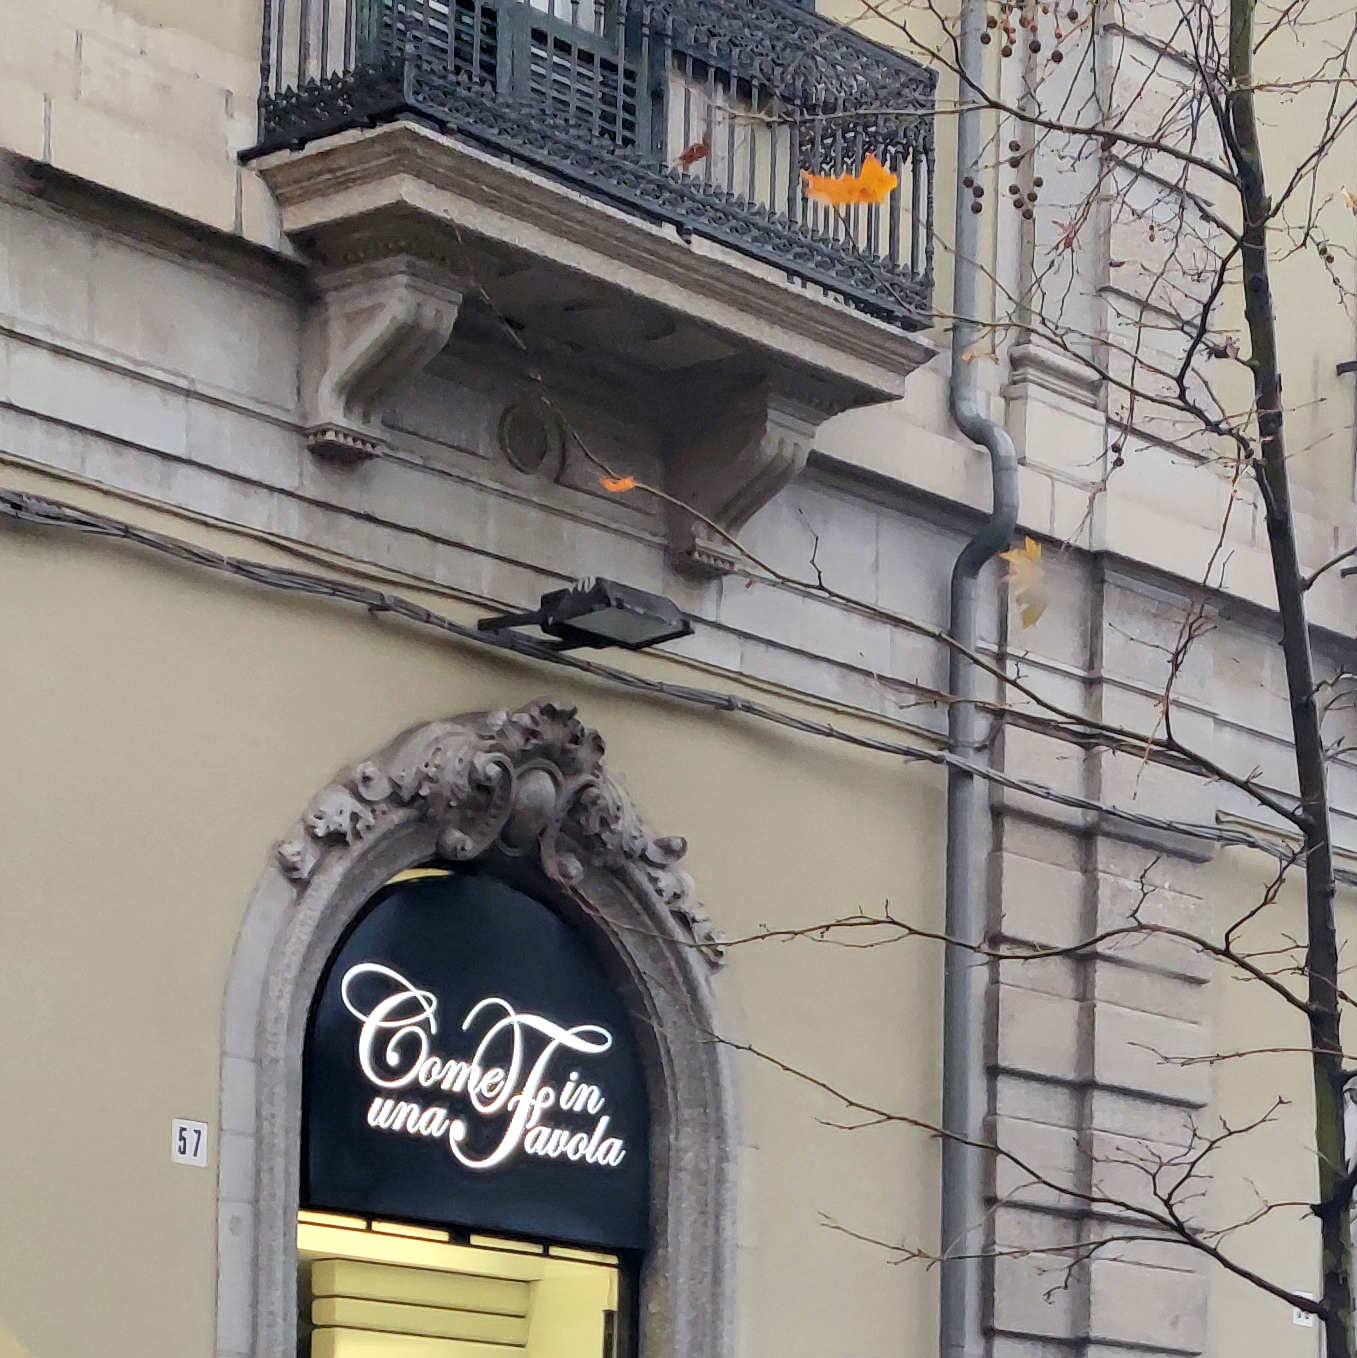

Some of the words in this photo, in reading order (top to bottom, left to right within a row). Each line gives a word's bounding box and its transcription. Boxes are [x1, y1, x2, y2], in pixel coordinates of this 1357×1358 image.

[341, 962, 506, 1098] Come
[559, 1071, 606, 1115] in
[366, 1097, 450, 1138] una
[178, 1126, 202, 1157] 57
